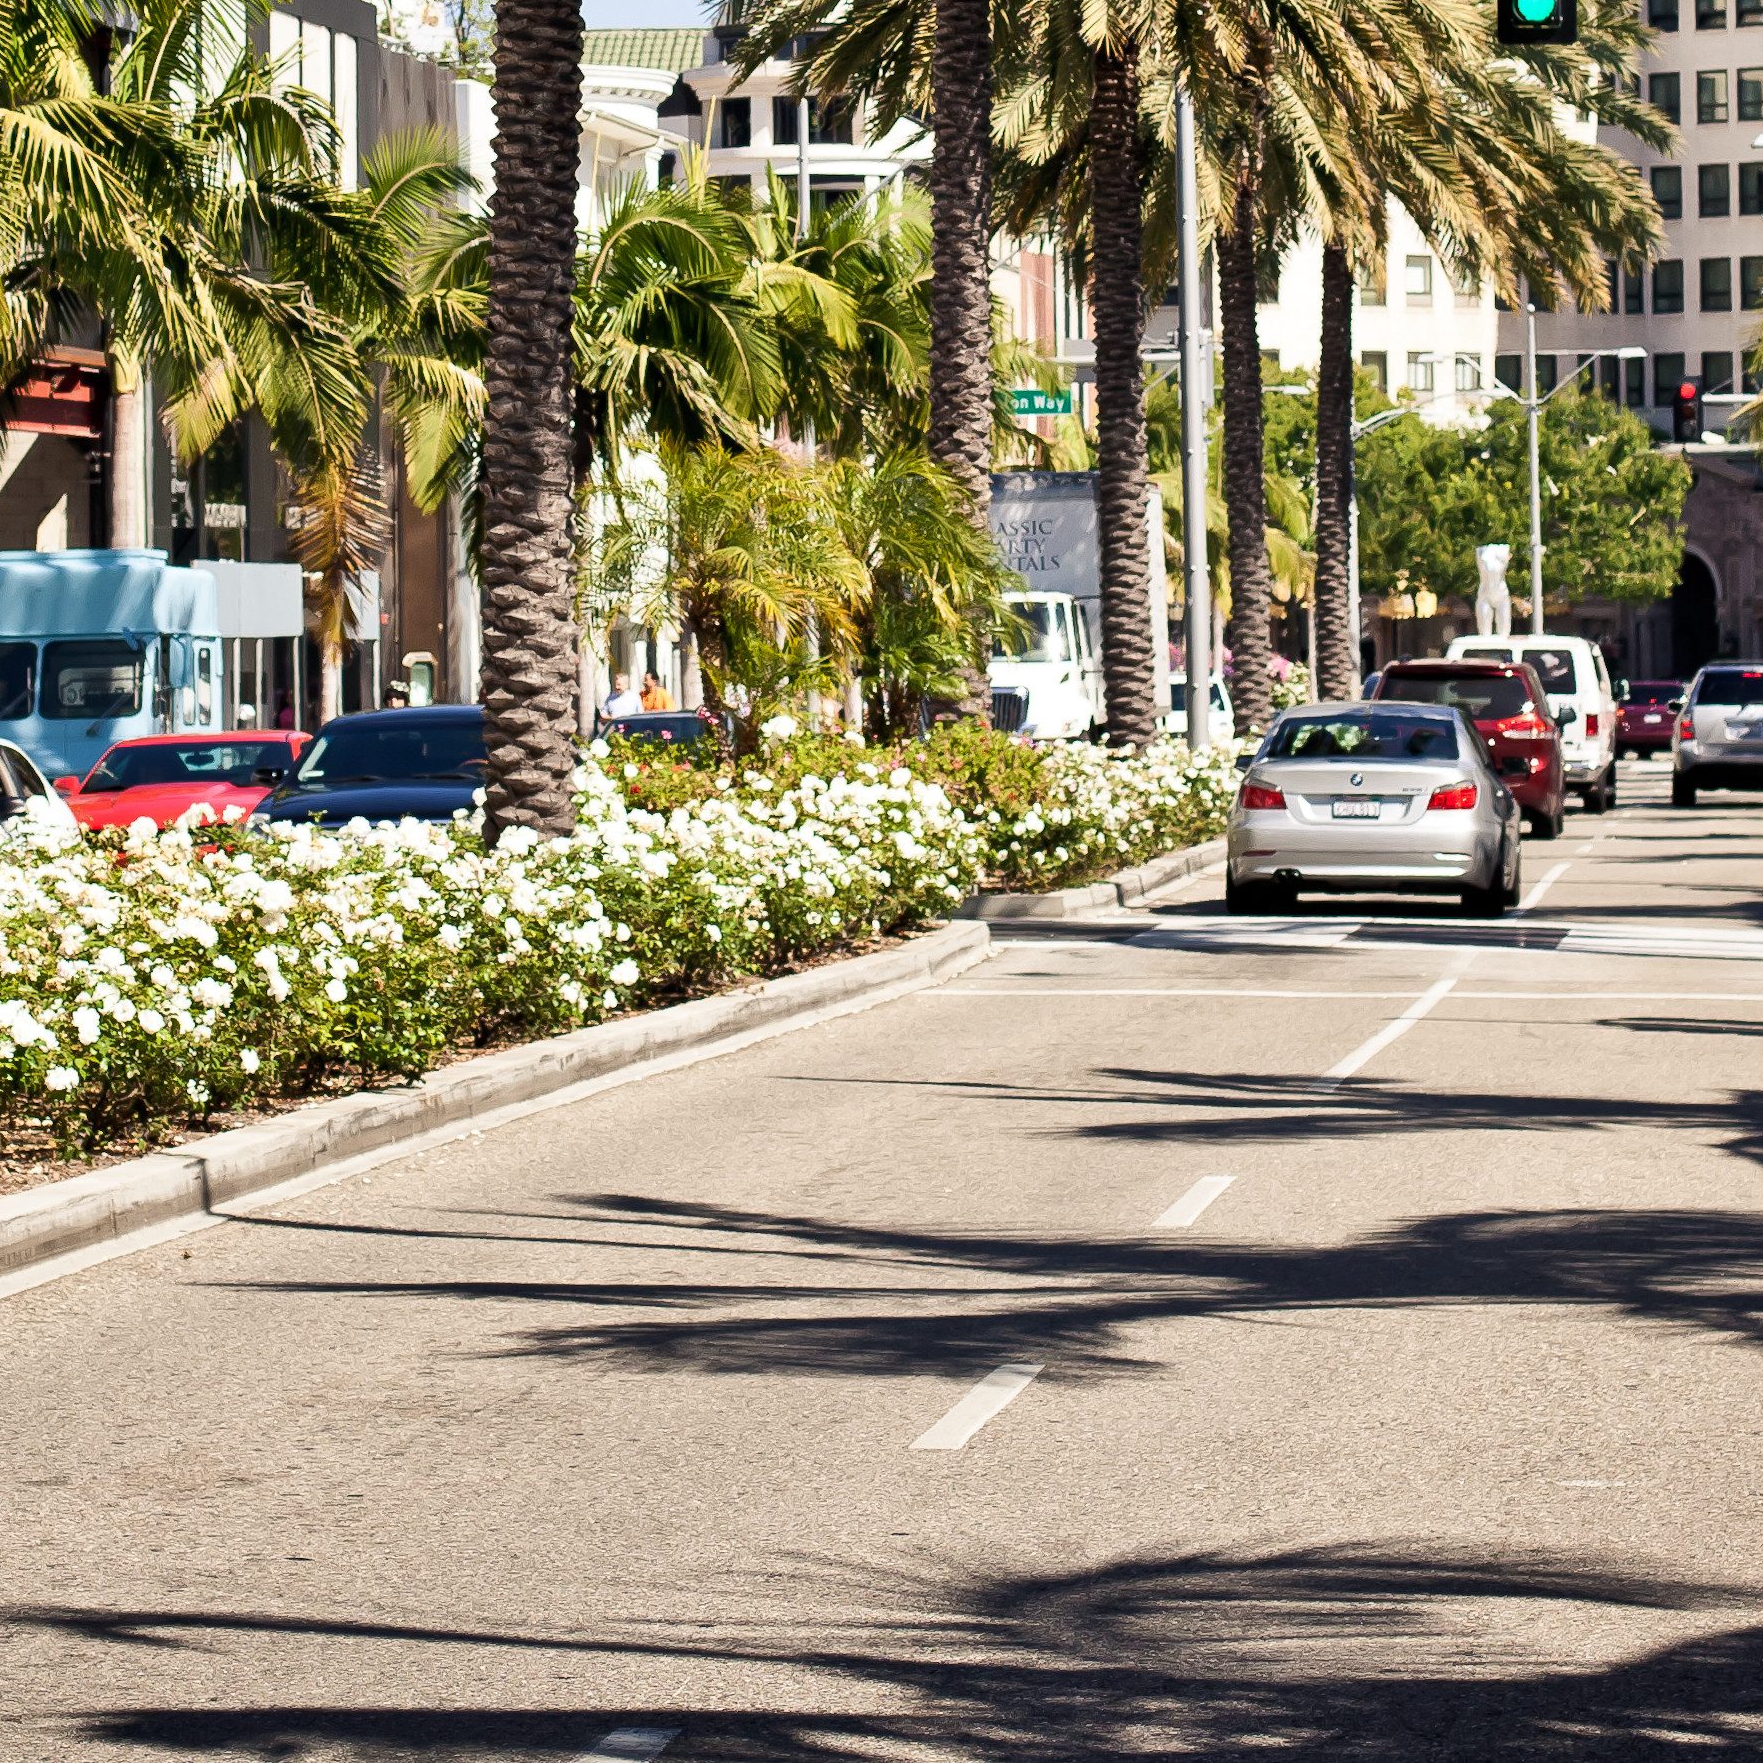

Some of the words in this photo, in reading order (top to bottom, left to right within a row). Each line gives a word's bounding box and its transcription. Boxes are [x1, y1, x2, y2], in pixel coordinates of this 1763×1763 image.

[1010, 398, 1030, 410] on
[1033, 395, 1065, 413] Way
[997, 518, 1054, 536] ASSIC
[997, 537, 1046, 554] ARTY
[998, 556, 1061, 572] NTALS
